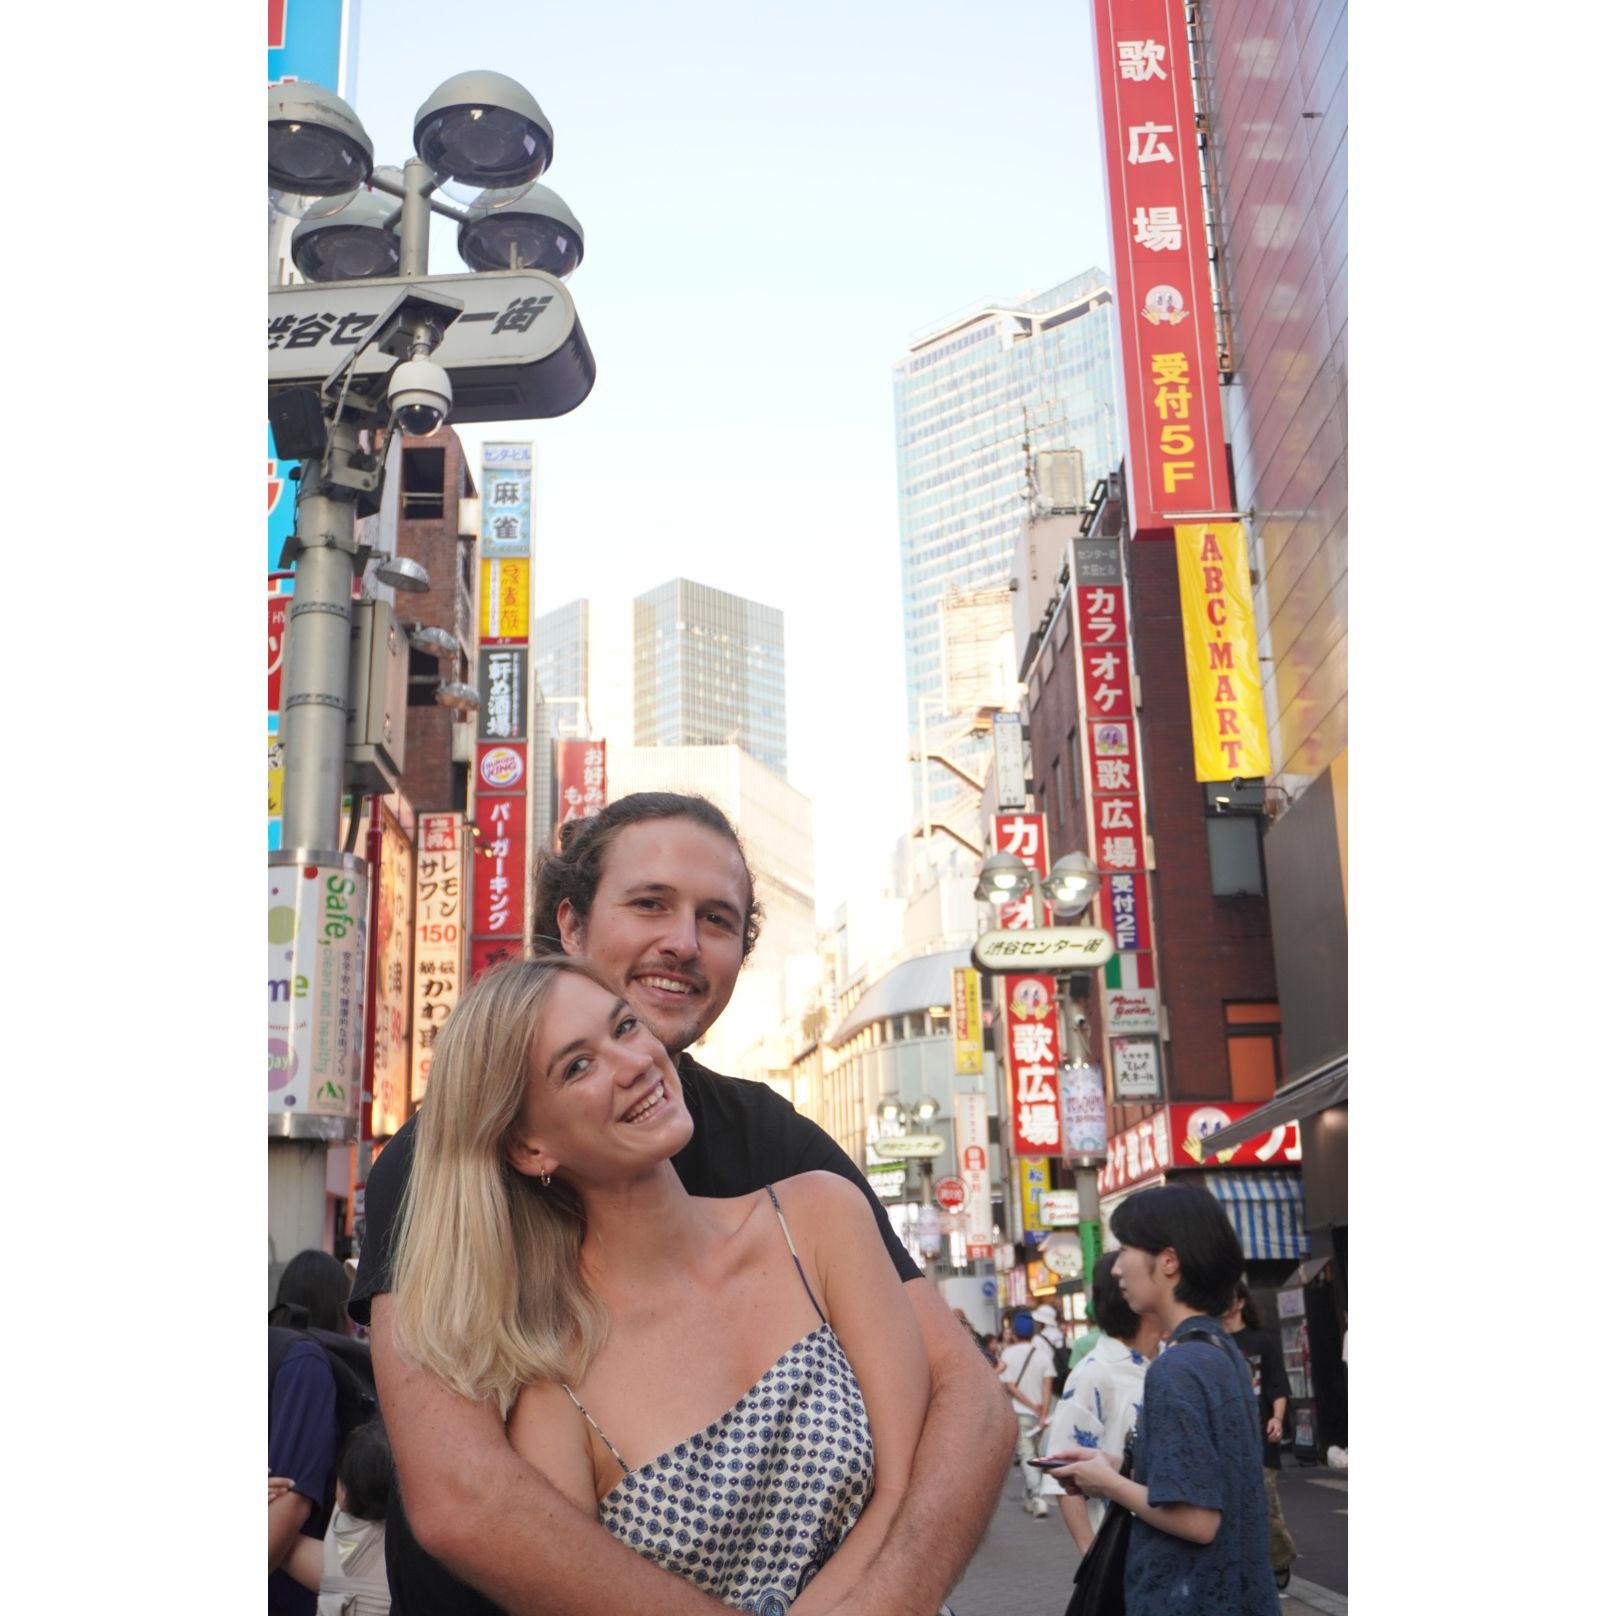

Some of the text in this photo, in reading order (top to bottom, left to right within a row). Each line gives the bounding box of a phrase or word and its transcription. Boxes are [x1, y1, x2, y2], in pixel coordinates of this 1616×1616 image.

[1118, 39, 1183, 253] 歌広場
[268, 294, 554, 351] 渋谷セー街
[1150, 351, 1196, 494] 受付5F
[494, 481, 520, 540] 麻雀
[1084, 588, 1125, 713] カラオケ
[1094, 759, 1138, 868] 歌広場
[419, 858, 439, 920] サワー
[441, 853, 459, 918] レモン
[488, 802, 511, 931] バーガーキング
[318, 874, 356, 946] Safe,
[419, 924, 457, 943] 150
[984, 937, 1106, 956] 渋谷センター街
[1110, 875, 1138, 949] 受付2F
[1012, 1024, 1061, 1146] 歌広場
